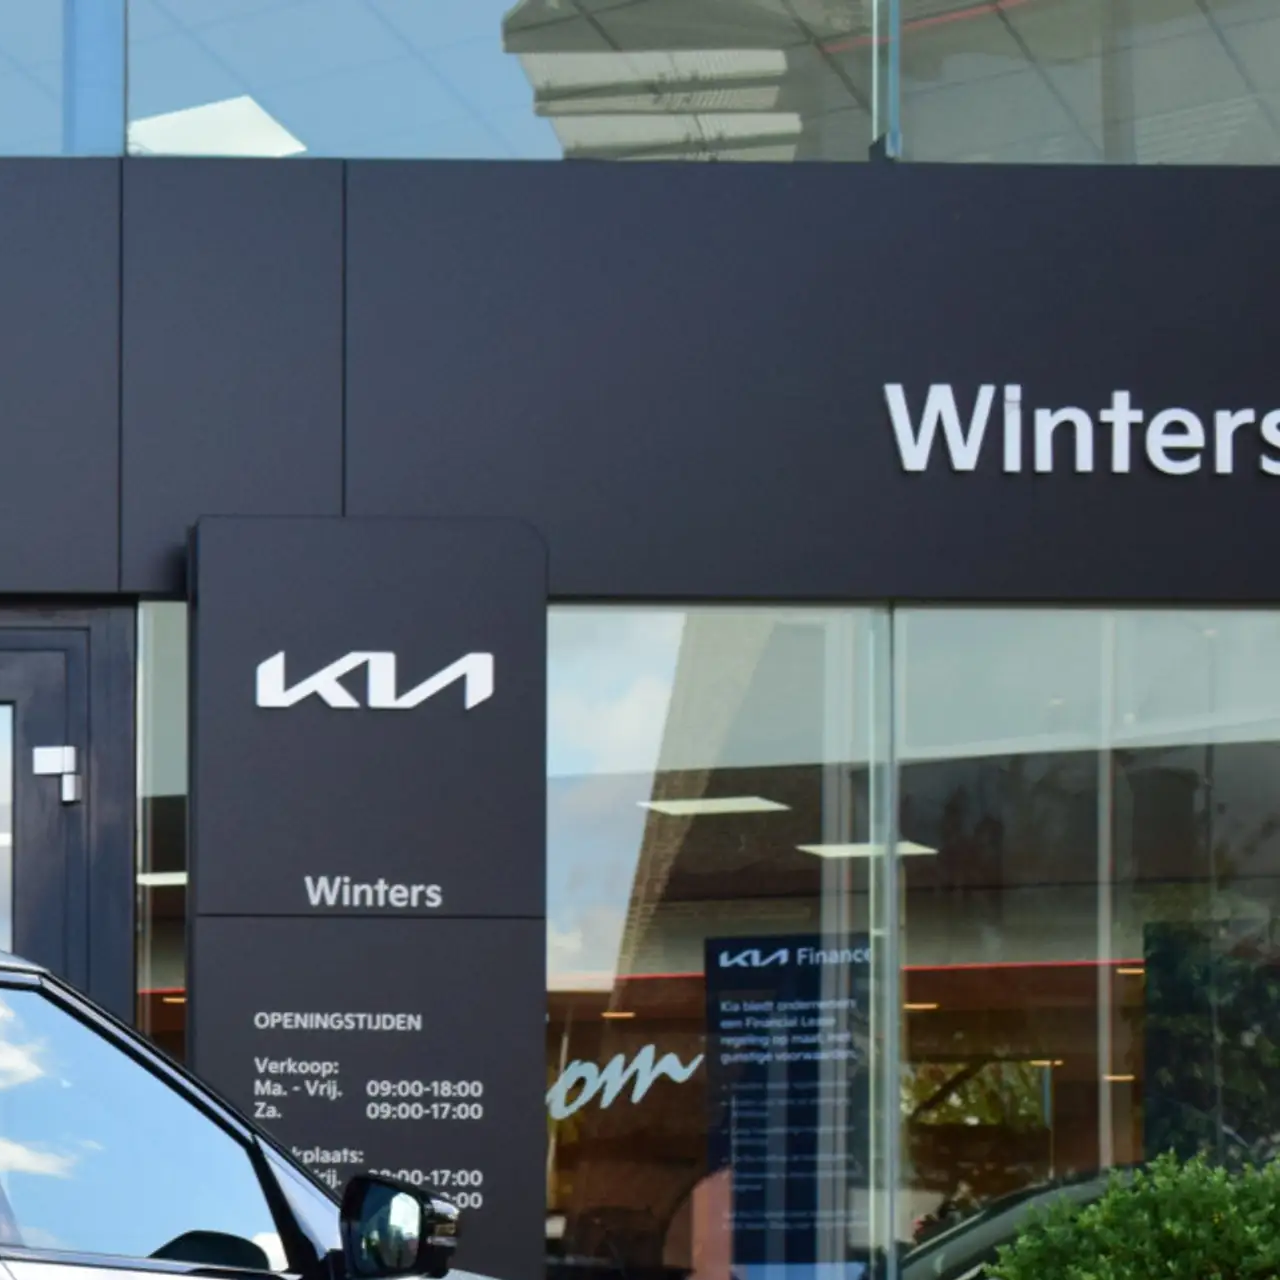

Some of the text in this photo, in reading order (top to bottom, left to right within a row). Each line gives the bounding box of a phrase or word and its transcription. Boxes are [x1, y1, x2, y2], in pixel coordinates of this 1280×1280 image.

[256, 650, 494, 710] KIA
[303, 875, 443, 908] Winters
[719, 948, 789, 967] KIA
[253, 1011, 422, 1031] OPENINGSTIJDEN
[253, 1056, 340, 1078] Verkoop:
[253, 1080, 288, 1097] Ma.
[304, 1080, 343, 1101] Vrij.
[365, 1080, 484, 1098] 09:00-18:00
[253, 1102, 484, 1120] Za. 09:00-17:00
